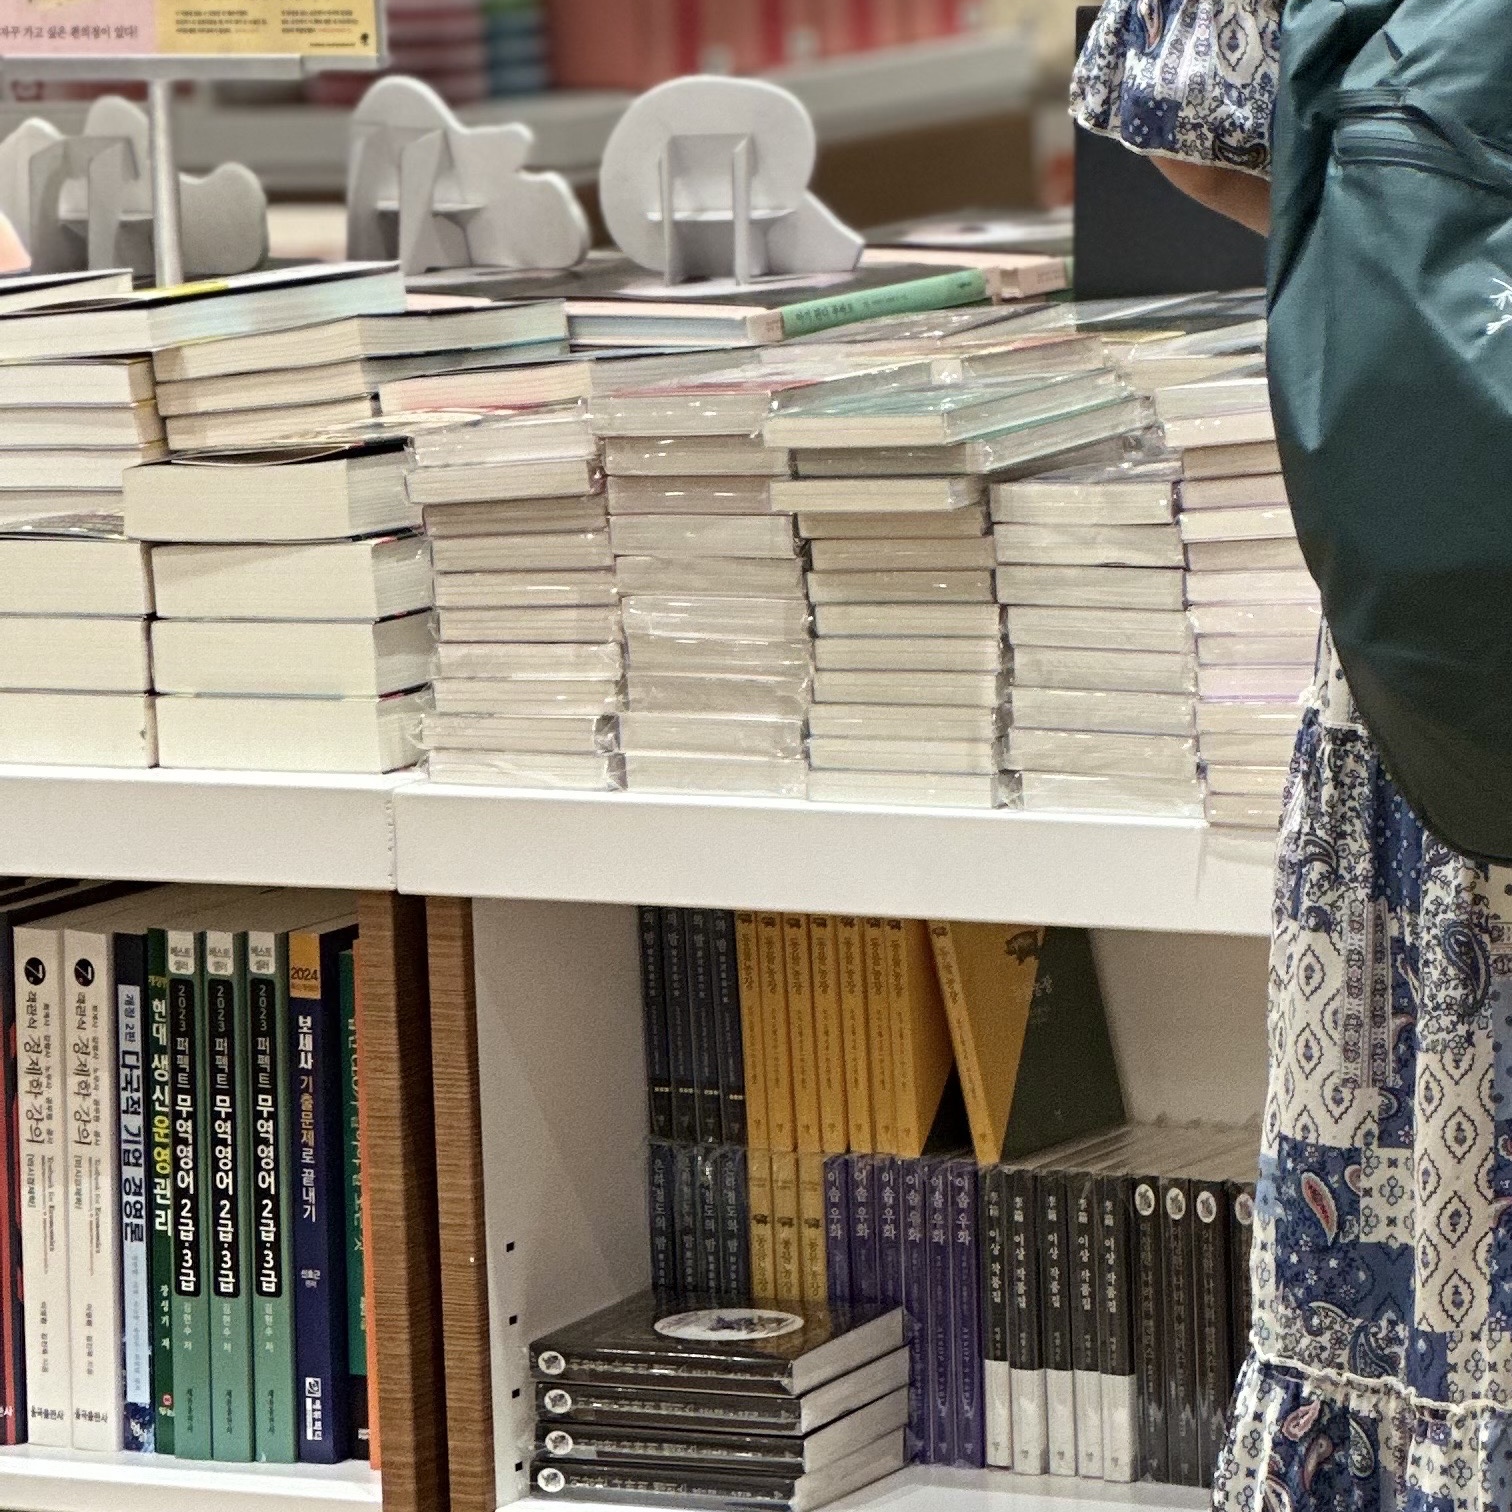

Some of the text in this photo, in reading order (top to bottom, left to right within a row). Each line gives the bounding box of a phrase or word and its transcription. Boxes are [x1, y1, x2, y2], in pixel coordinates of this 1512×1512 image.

[291, 967, 318, 981] 2024
[178, 985, 186, 1032] 2023
[217, 985, 225, 1032] 2023
[259, 985, 267, 1031] 2023
[24, 991, 45, 1144] 객관식 경제학 강의
[73, 992, 92, 1145] 객관식 경제학 강의
[176, 1037, 191, 1088] 퍼펙트
[215, 1037, 230, 1088] 퍼펙트
[257, 1037, 272, 1088] 퍼펙트
[298, 1015, 314, 1070] 보세사
[121, 1050, 142, 1115] 다국적
[123, 1124, 143, 1167] 기업
[175, 1094, 194, 1194] 무역영어
[214, 1094, 233, 1195] 무역영어
[256, 1094, 275, 1194] 무역영어
[123, 1176, 144, 1242] 경영론
[302, 1168, 316, 1222] 끝내기
